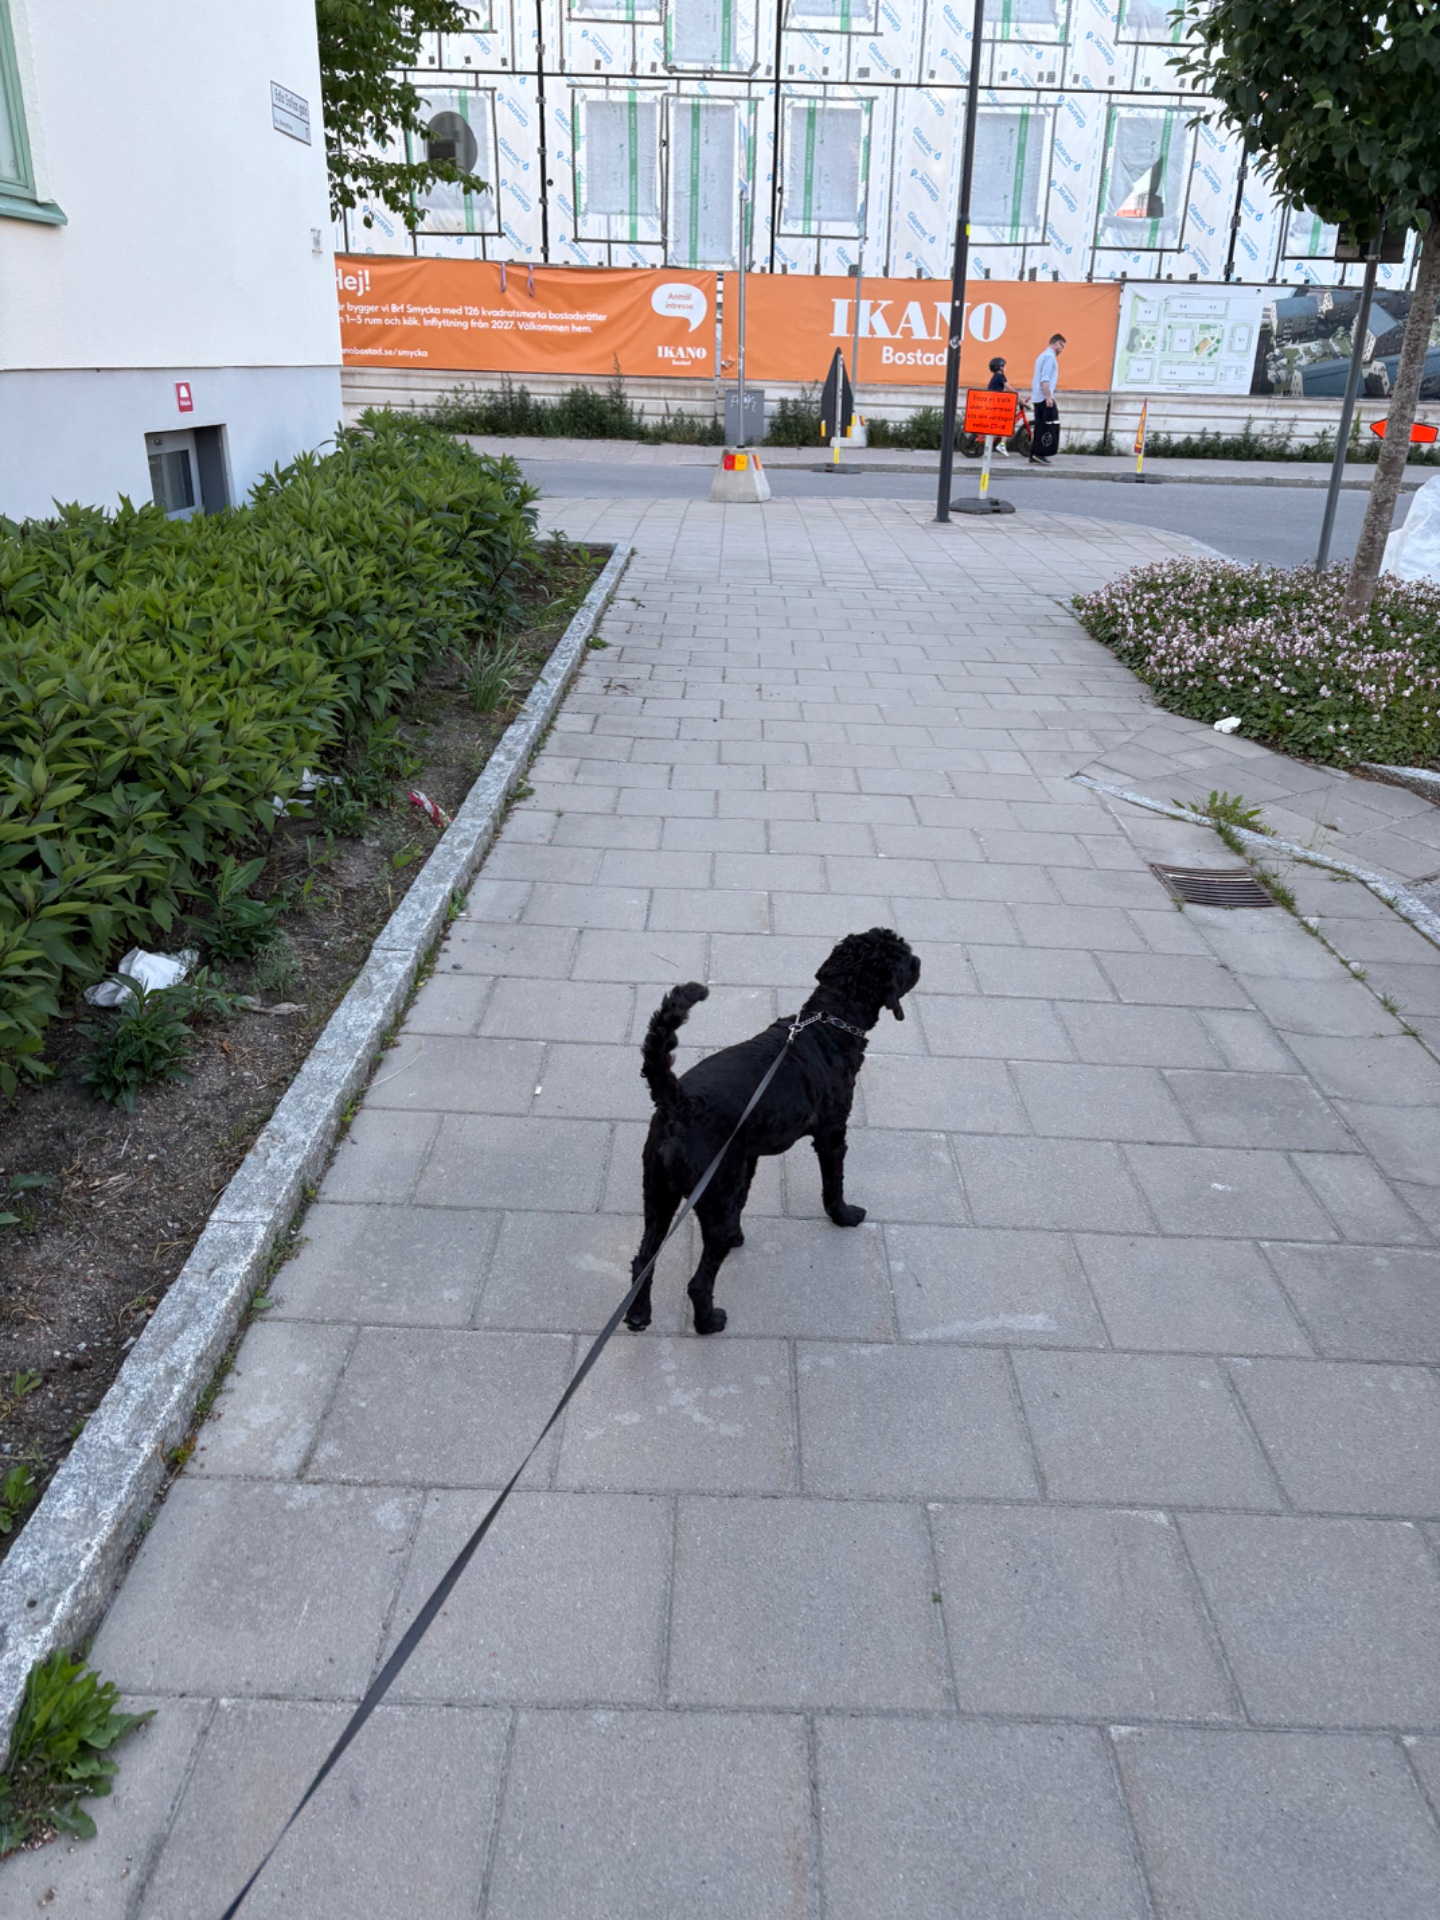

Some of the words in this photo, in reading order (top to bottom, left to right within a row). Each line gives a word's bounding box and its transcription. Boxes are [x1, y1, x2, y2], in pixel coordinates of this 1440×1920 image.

[880, 3, 901, 31] Glasroc
[943, 4, 963, 33] Glasroc
[590, 35, 613, 64] Glasroc
[869, 42, 890, 70] Glasroc
[1094, 37, 1114, 66] Glasroc
[949, 54, 970, 83] Glasroc
[504, 99, 528, 127] Glasroc
[924, 89, 945, 117] Glasroc
[1065, 101, 1086, 129] Glasroc
[499, 137, 521, 165] Glasroc
[913, 126, 934, 155] Glasroc
[1053, 138, 1074, 166] Glasroc
[918, 174, 939, 202] Glasroc
[1202, 166, 1221, 194] Glasroc
[510, 184, 531, 212] Glasroc
[1057, 187, 1078, 213] Glasroc
[908, 211, 929, 239] Glasroc
[1188, 203, 1209, 231] Glasroc
[502, 221, 524, 249] Glasroc
[1046, 222, 1065, 249] Glasroc
[1238, 233, 1258, 261] Glasroc
[1190, 249, 1210, 276] Glasroc
[347, 302, 379, 315] bygger
[381, 303, 390, 313] vi
[391, 303, 404, 313] Brf
[406, 304, 441, 316] Smycka
[442, 306, 463, 315] med
[464, 306, 480, 316] 126
[481, 307, 547, 319] kvadratsmarta
[548, 310, 607, 321] bostadsrätter
[364, 317, 383, 325] rum
[384, 316, 401, 325] och
[402, 316, 422, 326] kök.
[423, 317, 469, 330] Inflyttning
[470, 319, 489, 329] från
[490, 319, 516, 330] 2027.
[517, 321, 570, 332] Välkommen
[571, 323, 593, 333] hem.
[829, 298, 1007, 343] IKANO
[657, 345, 707, 360] IKANO
[881, 345, 949, 366] Bostad
